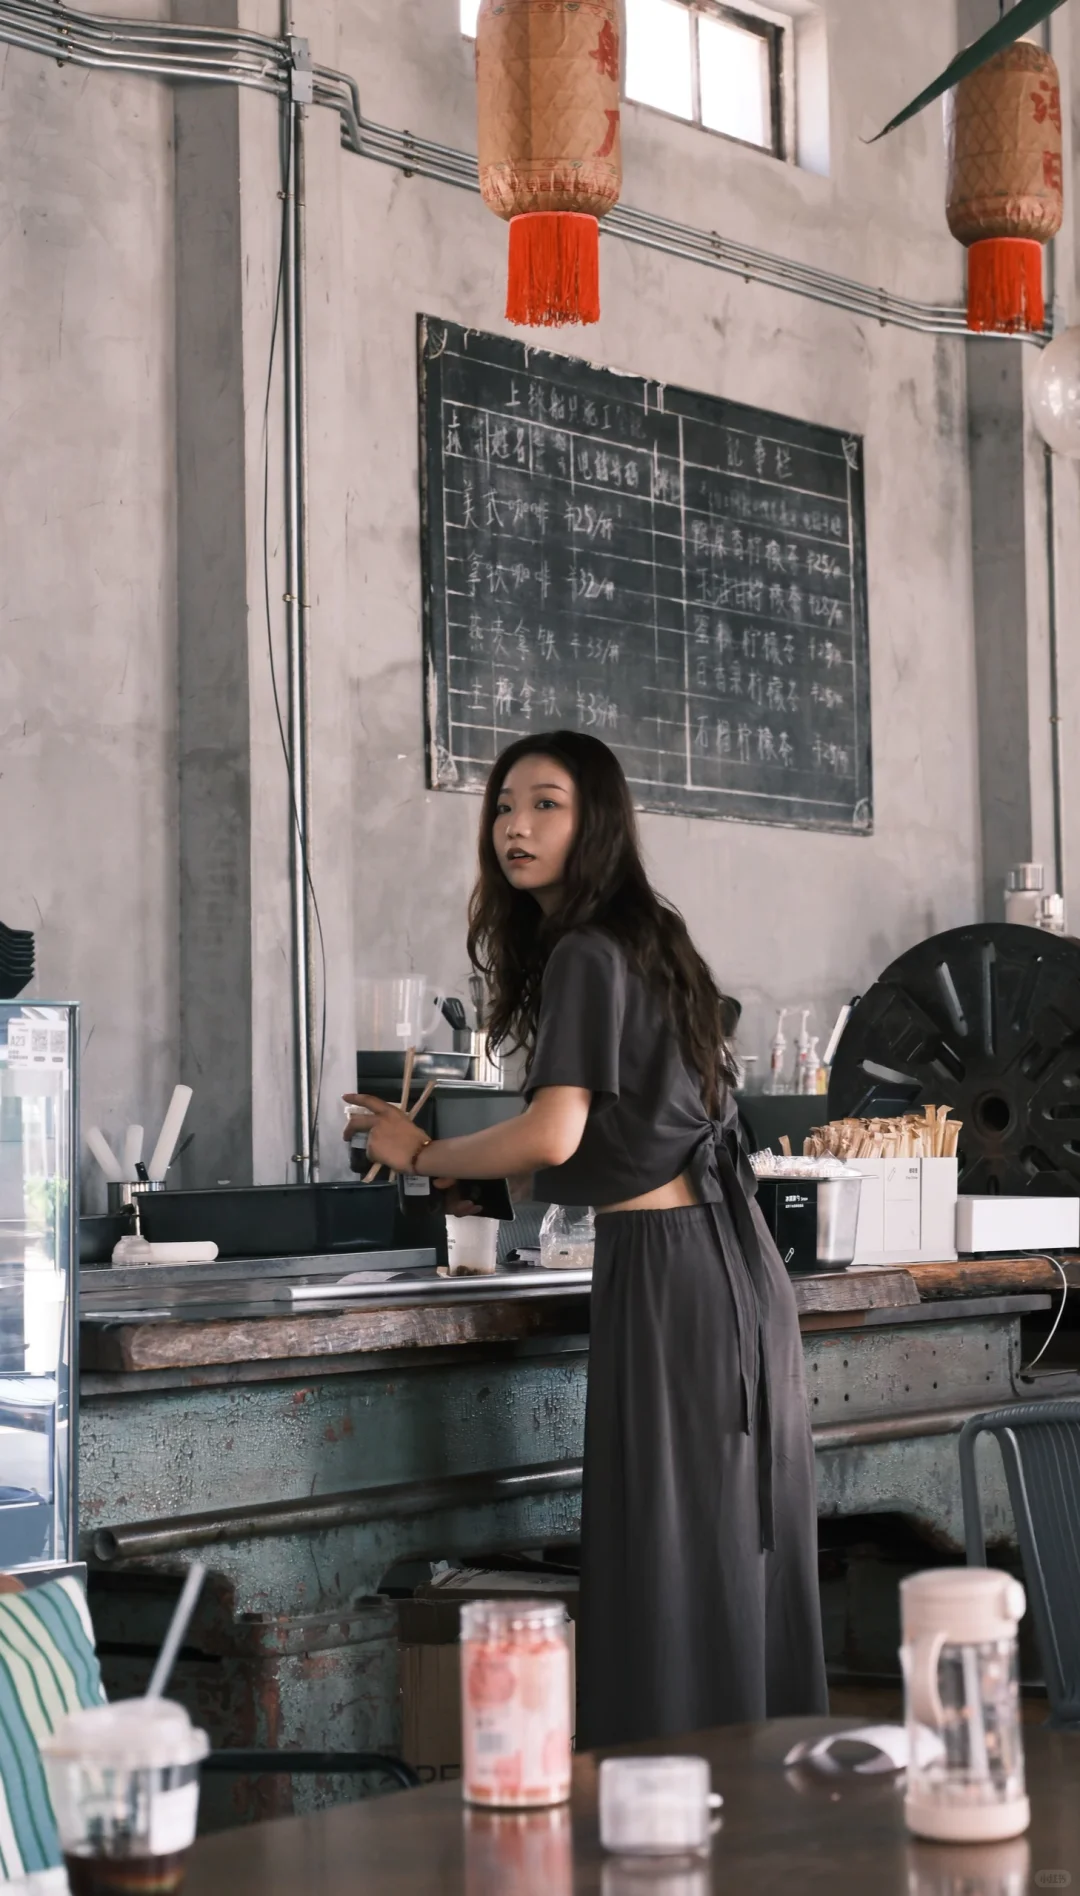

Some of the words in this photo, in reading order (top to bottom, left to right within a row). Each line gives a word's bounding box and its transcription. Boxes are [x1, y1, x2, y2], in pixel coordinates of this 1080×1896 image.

[463, 478, 550, 535] 美式咖啡
[467, 551, 551, 599] 拿铁咖啡
[469, 613, 561, 662] 燕麦拿铁
